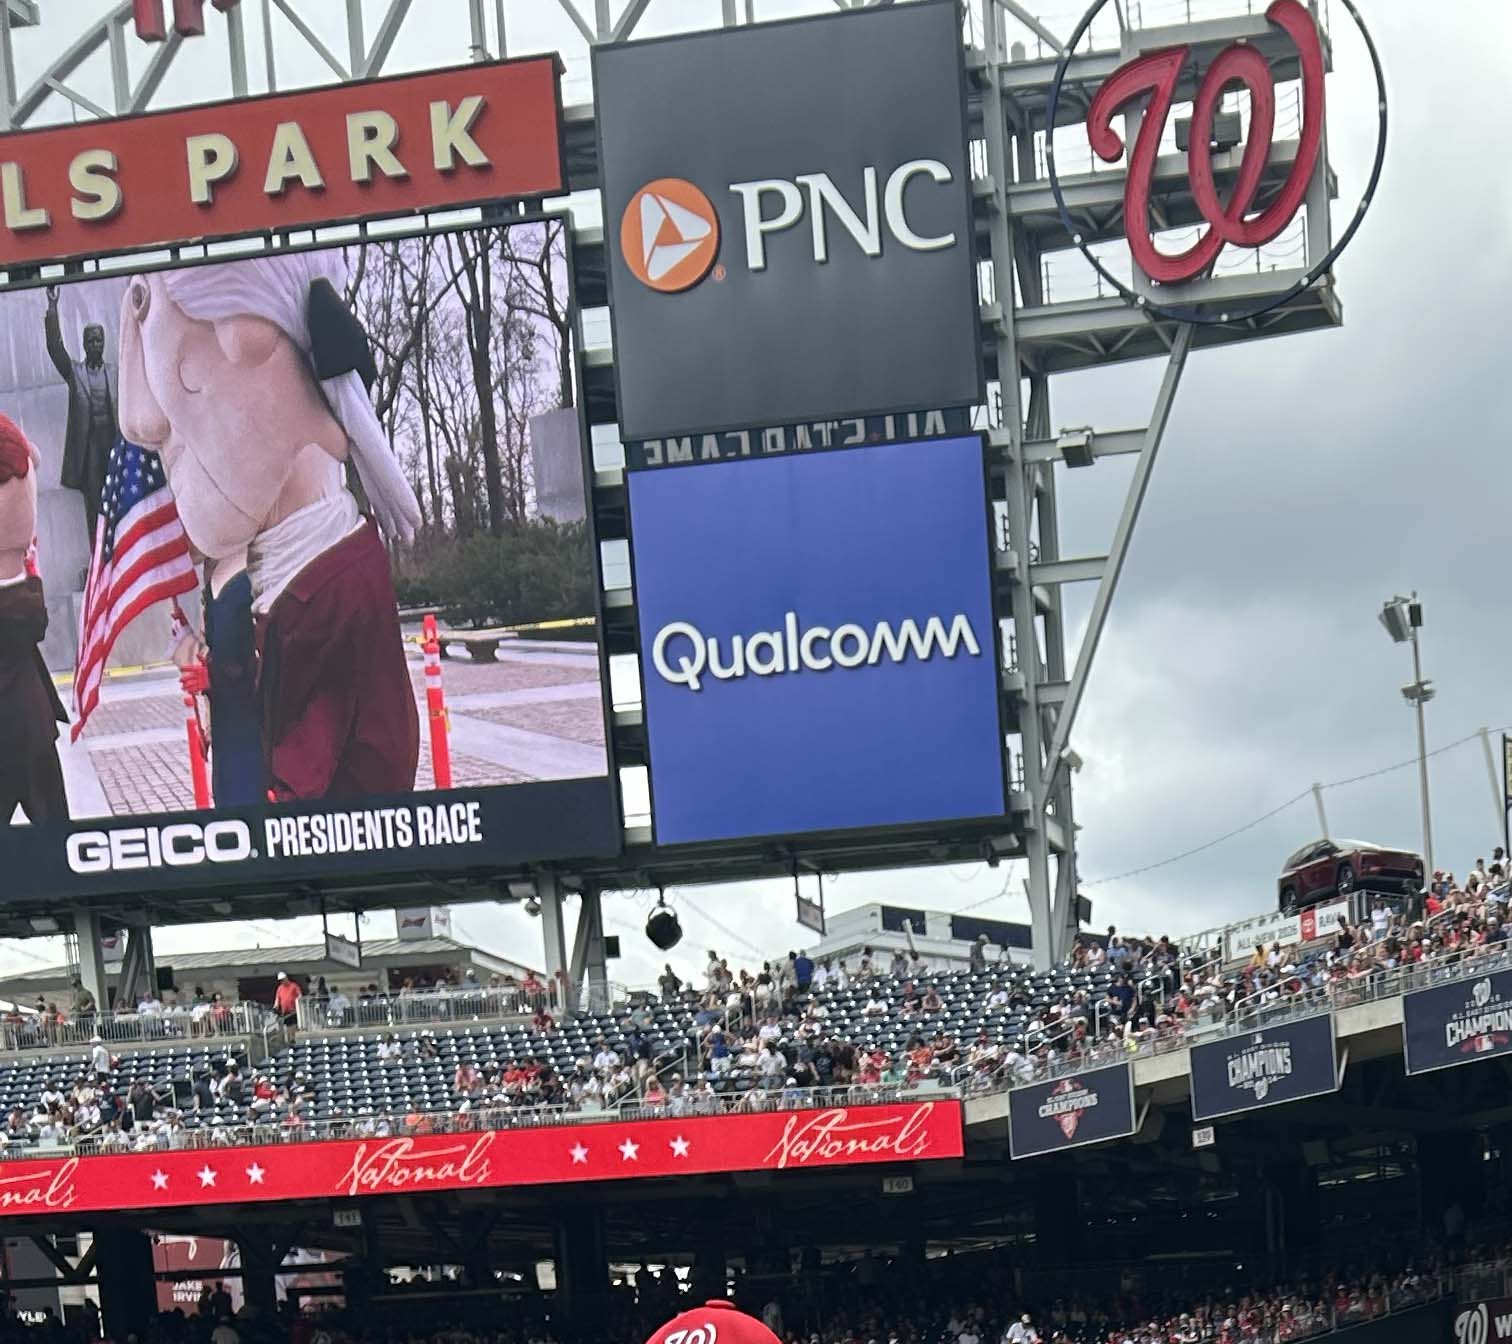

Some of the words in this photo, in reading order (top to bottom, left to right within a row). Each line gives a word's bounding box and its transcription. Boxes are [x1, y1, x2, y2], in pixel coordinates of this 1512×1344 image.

[0, 149, 123, 230] LS
[186, 95, 492, 204] PARK
[729, 158, 957, 271] PNC
[652, 612, 981, 691] Qualcomm
[66, 819, 252, 874] GEICO
[265, 807, 414, 858] PRESIDENTS
[416, 802, 483, 848] RACE
[336, 1131, 497, 1197] Nationals
[764, 1102, 936, 1168] Nationals
[0, 1157, 79, 1209] nals
